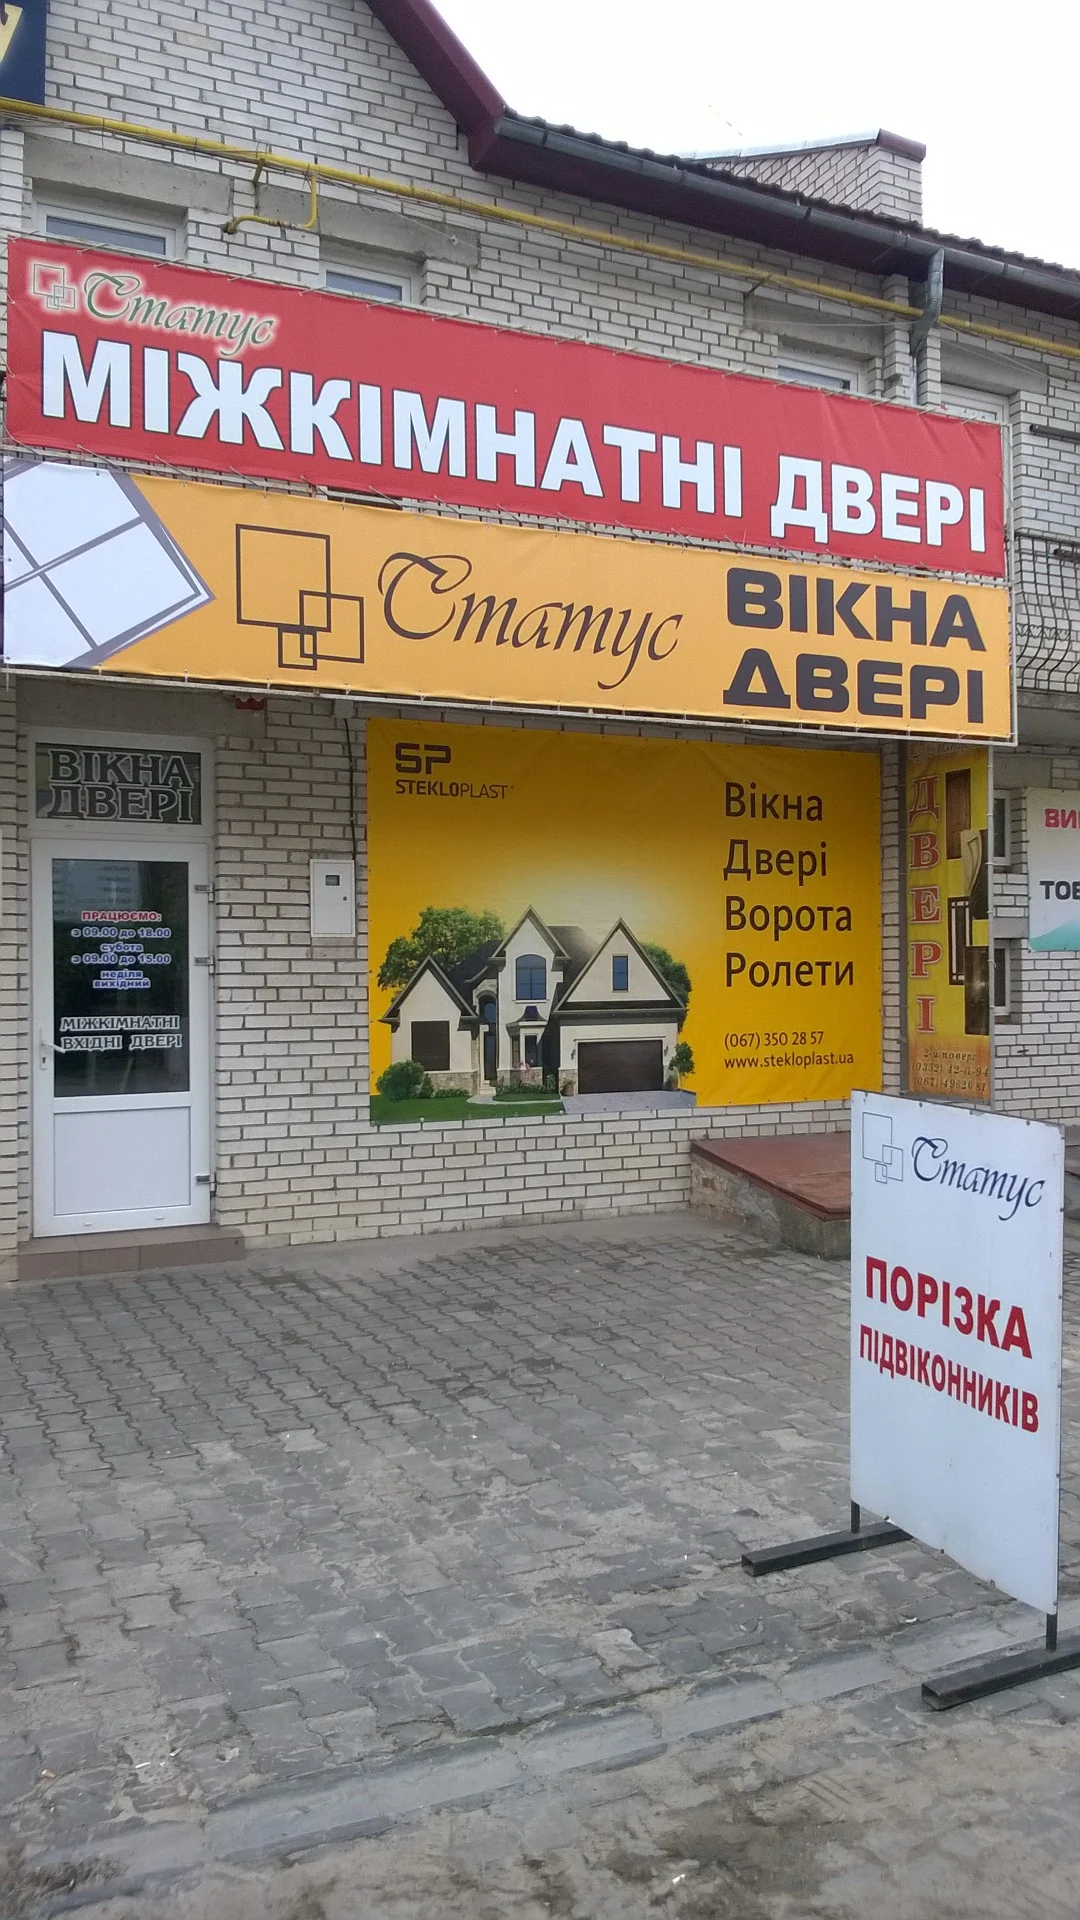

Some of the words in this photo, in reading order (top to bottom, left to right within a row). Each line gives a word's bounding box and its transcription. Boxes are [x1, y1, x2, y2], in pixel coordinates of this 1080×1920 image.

[84, 271, 276, 356] Статус
[41, 330, 743, 518] МІЖКІМНАТНІ
[769, 453, 986, 553] ДВЕРІ
[377, 551, 683, 690] Статус
[726, 567, 986, 652] ВІКНА
[723, 648, 984, 724] ДВЕРІ
[49, 750, 194, 788] ВІКНА
[395, 742, 452, 775] SP
[47, 783, 194, 823] ДВЕРІ
[395, 779, 509, 799] STEKLOPLAST
[725, 781, 823, 822] Вікна
[1044, 808, 1080, 829] ВИ
[723, 838, 827, 887] Двері
[82, 911, 161, 922] ПРАЦЮЄМО:
[725, 895, 852, 941] Ворота
[908, 774, 942, 1033] ДВЕРІ
[83, 927, 117, 938] 09.00
[119, 929, 136, 939] до
[138, 927, 171, 938] 18.00
[100, 942, 144, 954] субота
[83, 954, 117, 964] 09.00
[119, 955, 136, 965] до
[138, 954, 171, 964] 15.00
[100, 968, 143, 980] неділя
[726, 952, 854, 988] Ролети
[93, 978, 151, 989] вихідний
[60, 1015, 180, 1031] МІЖКІМНАТНІ
[724, 1032, 760, 1051] (067)
[764, 1032, 788, 1046] 350
[792, 1031, 807, 1046] 28
[811, 1031, 824, 1045] 57
[60, 1035, 122, 1052] ВХІДНІ
[129, 1034, 182, 1050] ДВЕРІ
[724, 1051, 854, 1069] www.stekloplast.ua
[911, 1136, 1046, 1221] Статус
[866, 1254, 1033, 1360] ПОРІЗКА
[859, 1323, 1039, 1434] ПІДВІКОННИКІВ
